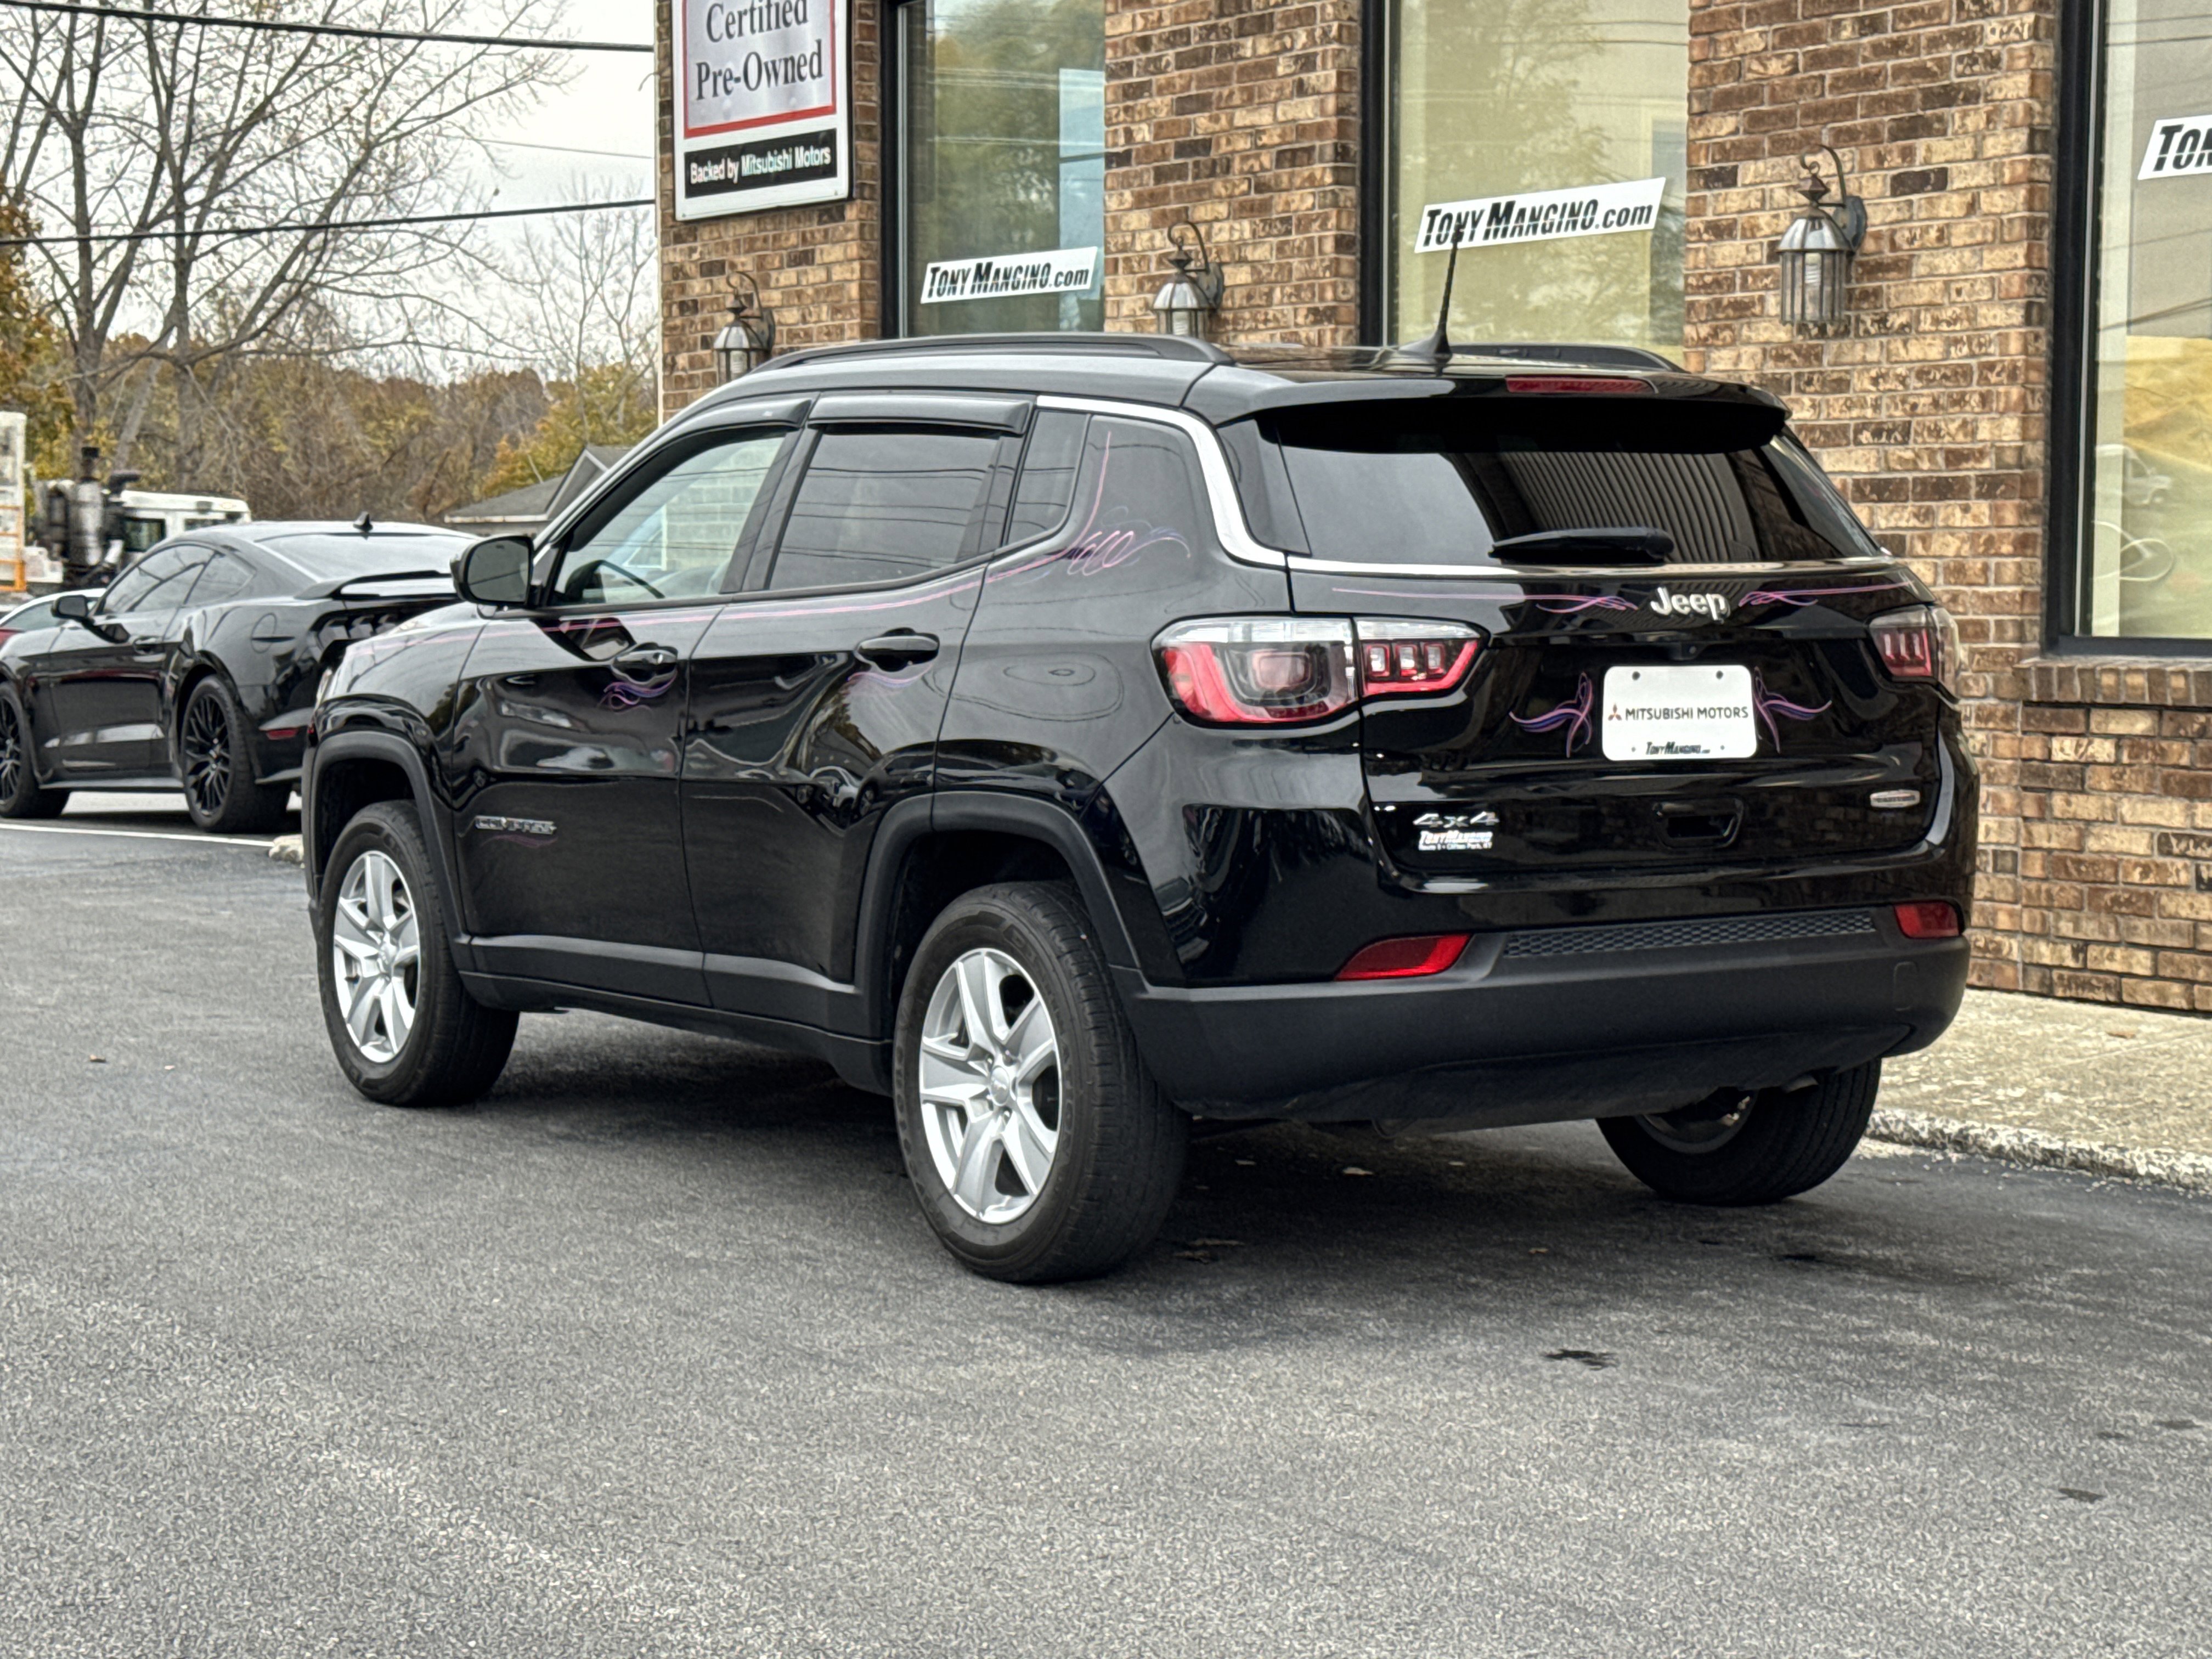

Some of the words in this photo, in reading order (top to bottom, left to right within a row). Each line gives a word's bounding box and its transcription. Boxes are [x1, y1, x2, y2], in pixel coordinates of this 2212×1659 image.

[707, 0, 809, 42] Certified
[696, 38, 823, 101] Pre-Owned
[691, 160, 726, 184] Backed
[727, 158, 739, 184] by
[741, 148, 793, 176] Mitsubishi
[795, 145, 831, 168] Motors
[1650, 586, 1730, 622] Jeep
[1625, 707, 1693, 720] MITSUBISHI
[1697, 706, 1748, 719] MOTORS
